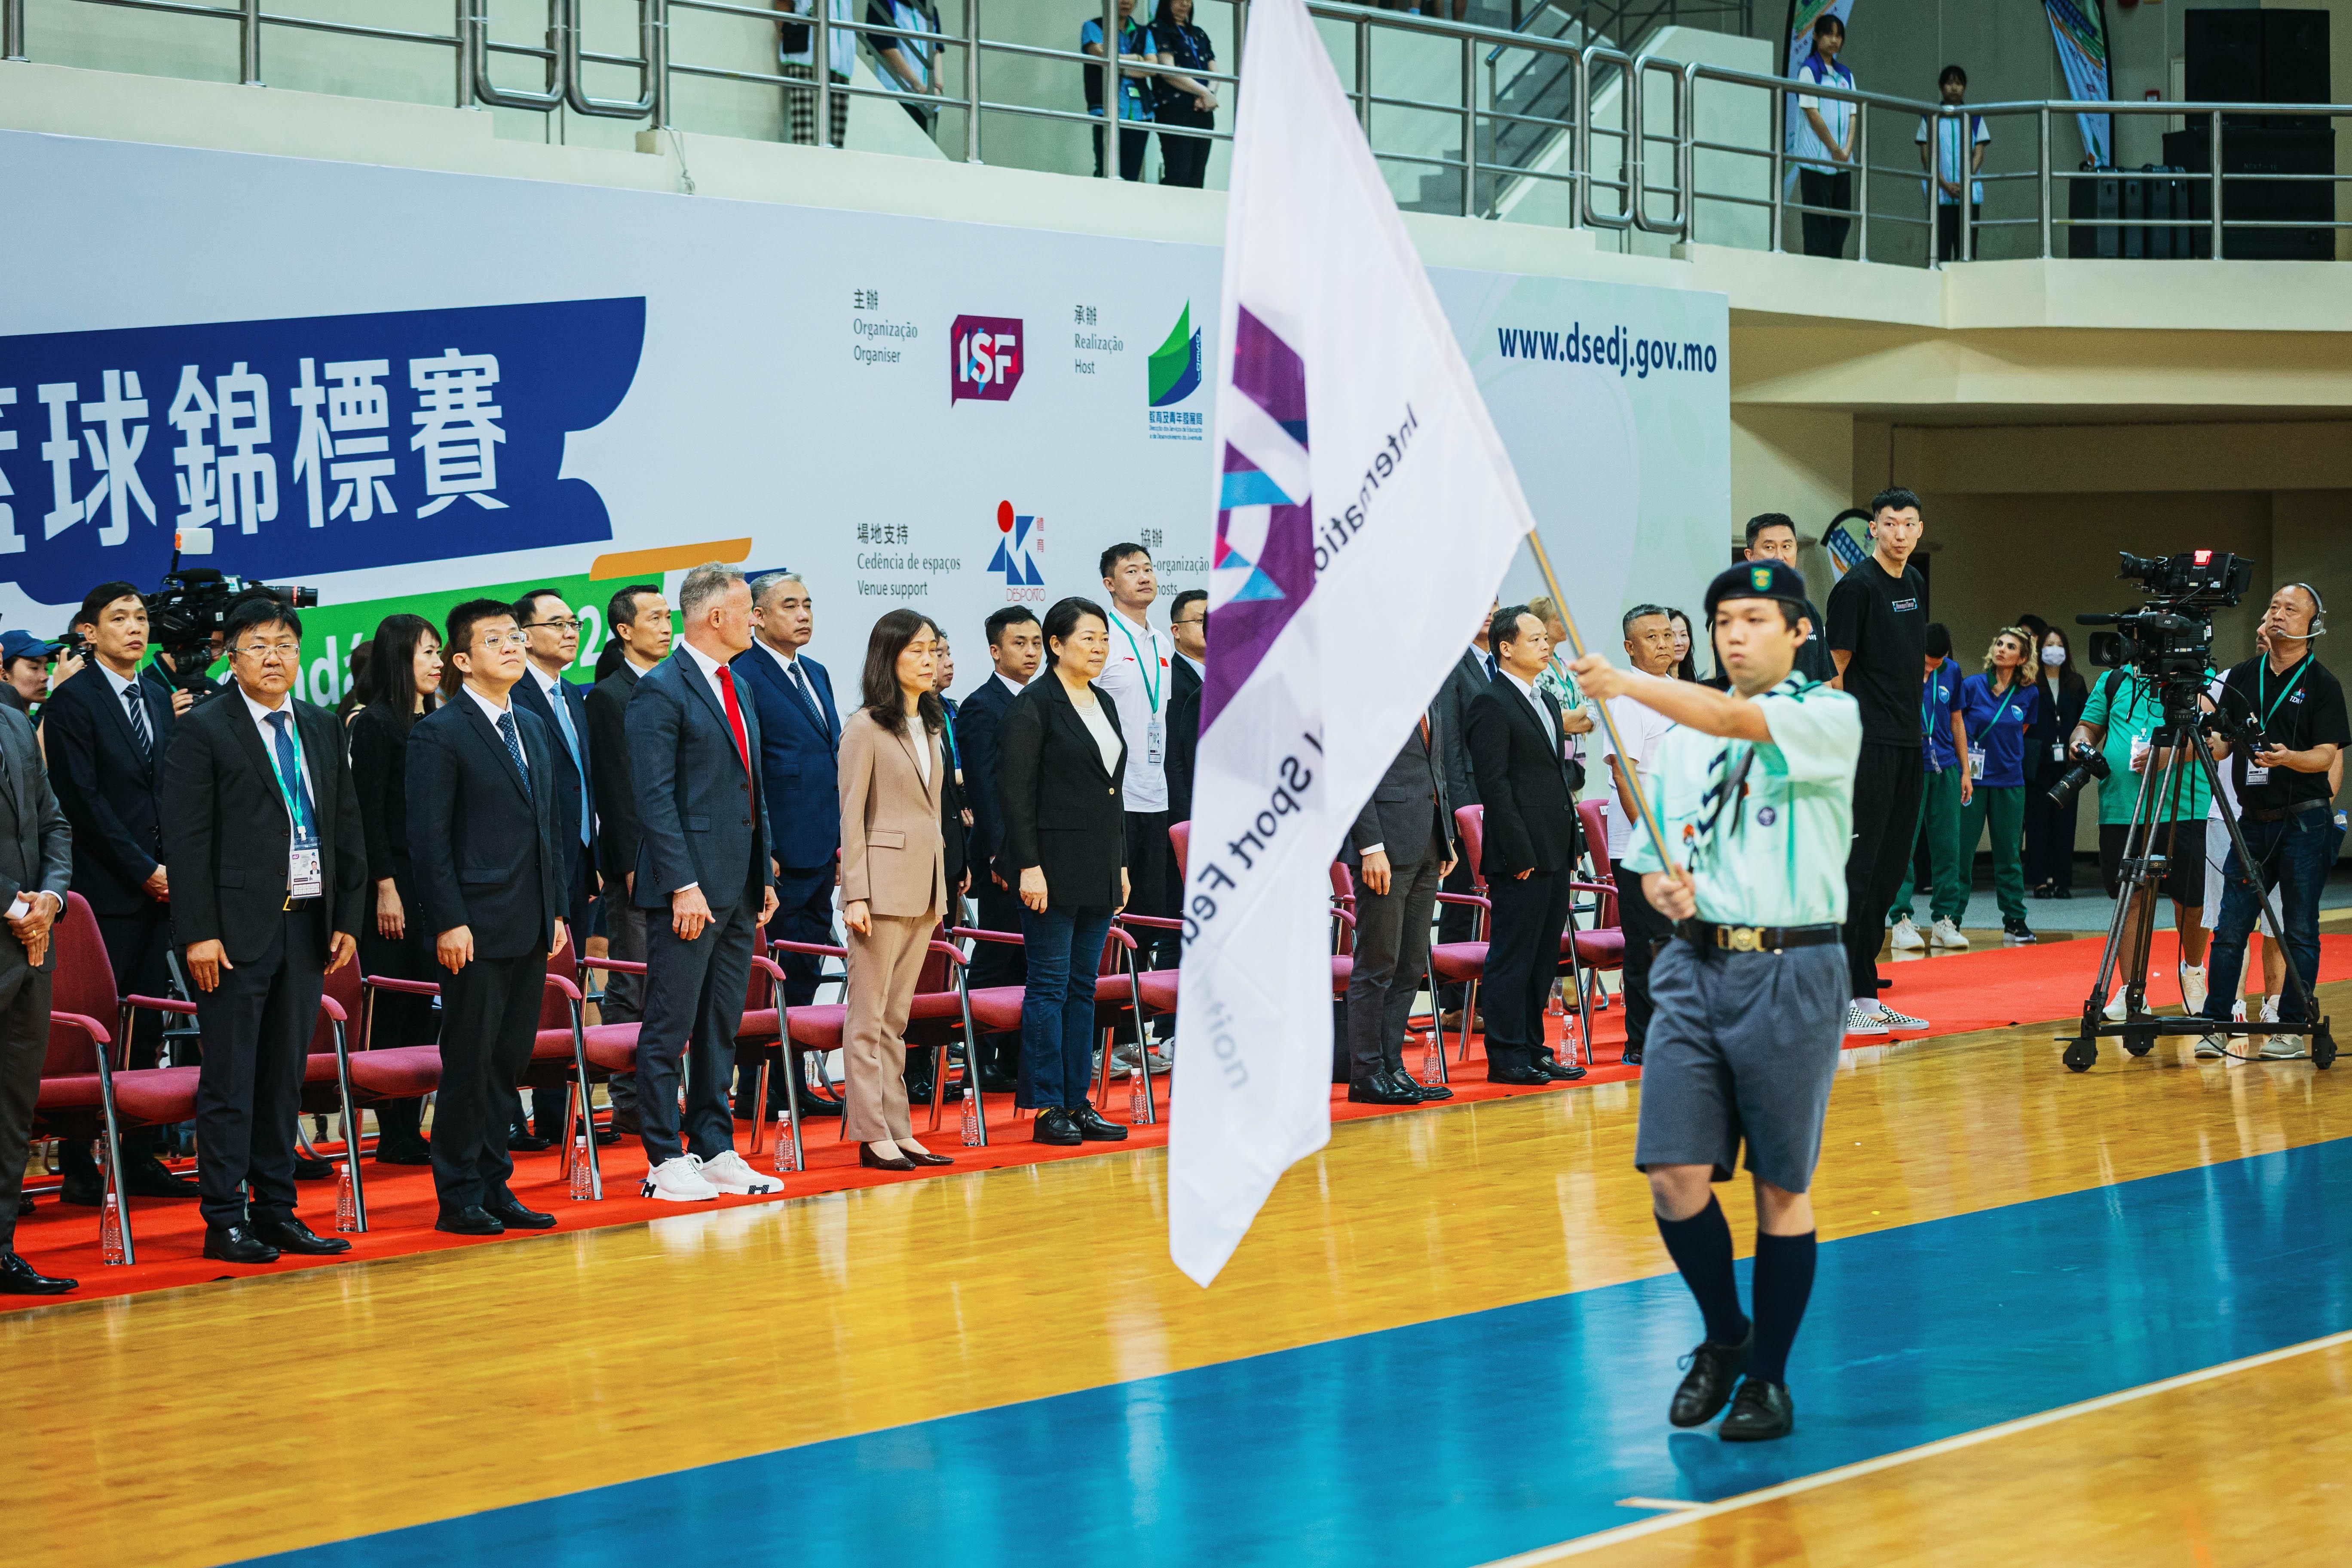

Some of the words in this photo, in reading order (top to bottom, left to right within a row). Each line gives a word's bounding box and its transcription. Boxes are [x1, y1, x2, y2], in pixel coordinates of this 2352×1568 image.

[854, 288, 878, 310] 主辦
[1075, 305, 1097, 326] 承辦
[853, 318, 918, 342] Organização
[854, 345, 901, 365] Organiser
[1075, 333, 1124, 355] Realização
[1498, 321, 1718, 379] www.dsedj.gov.mo
[959, 332, 1016, 385] ISF
[1075, 358, 1095, 374] Host
[0, 347, 511, 554] 球錦標賽
[857, 523, 909, 545] 場地支持
[1140, 528, 1163, 548] 協辦
[857, 552, 904, 570] Cedência
[907, 552, 919, 570] de
[922, 557, 961, 575] espaços
[1153, 555, 1210, 576] -organização
[858, 580, 888, 595] Venue
[890, 582, 928, 600] support
